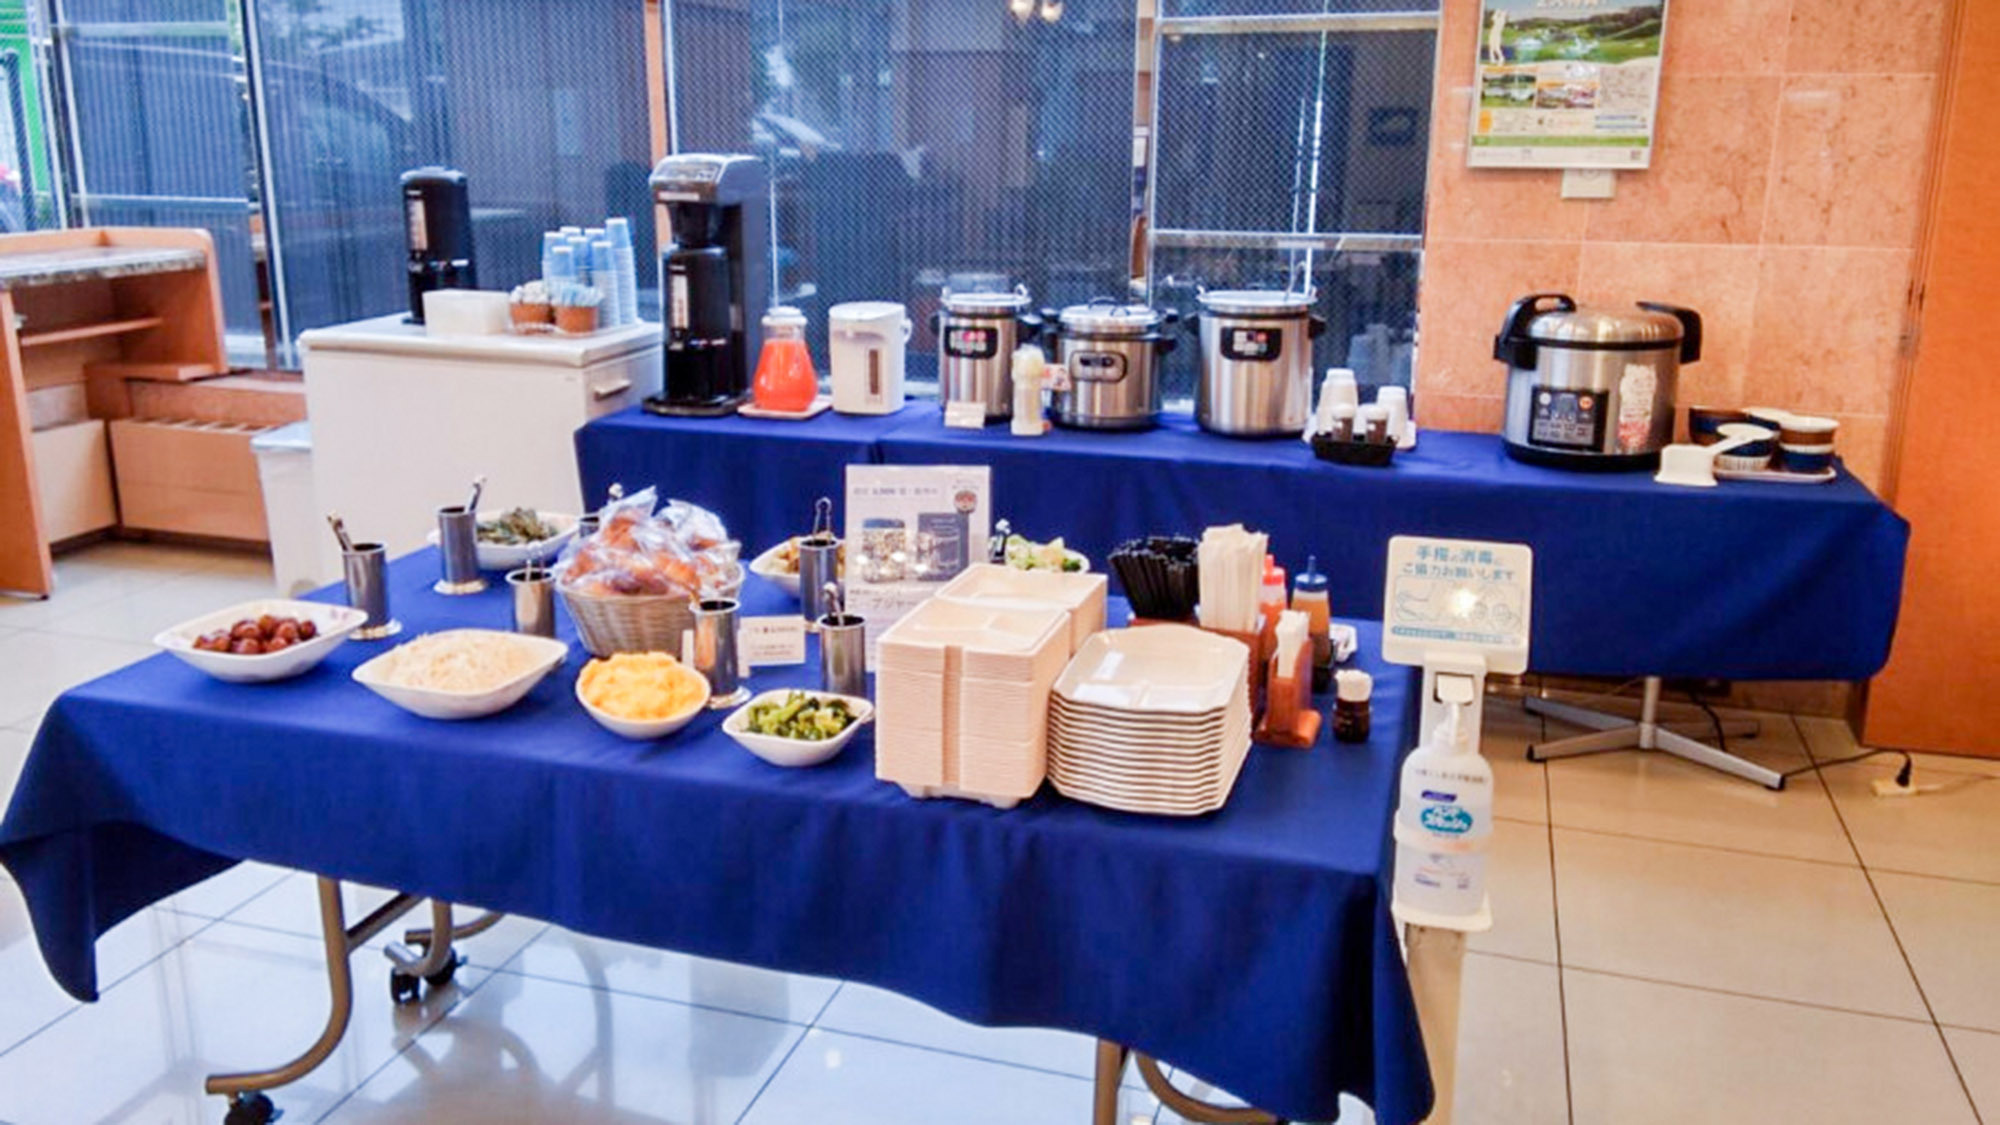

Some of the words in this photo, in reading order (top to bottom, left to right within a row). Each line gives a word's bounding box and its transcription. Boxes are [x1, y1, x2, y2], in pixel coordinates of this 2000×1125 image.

[1403, 563, 1515, 581] ご協力お願いします
